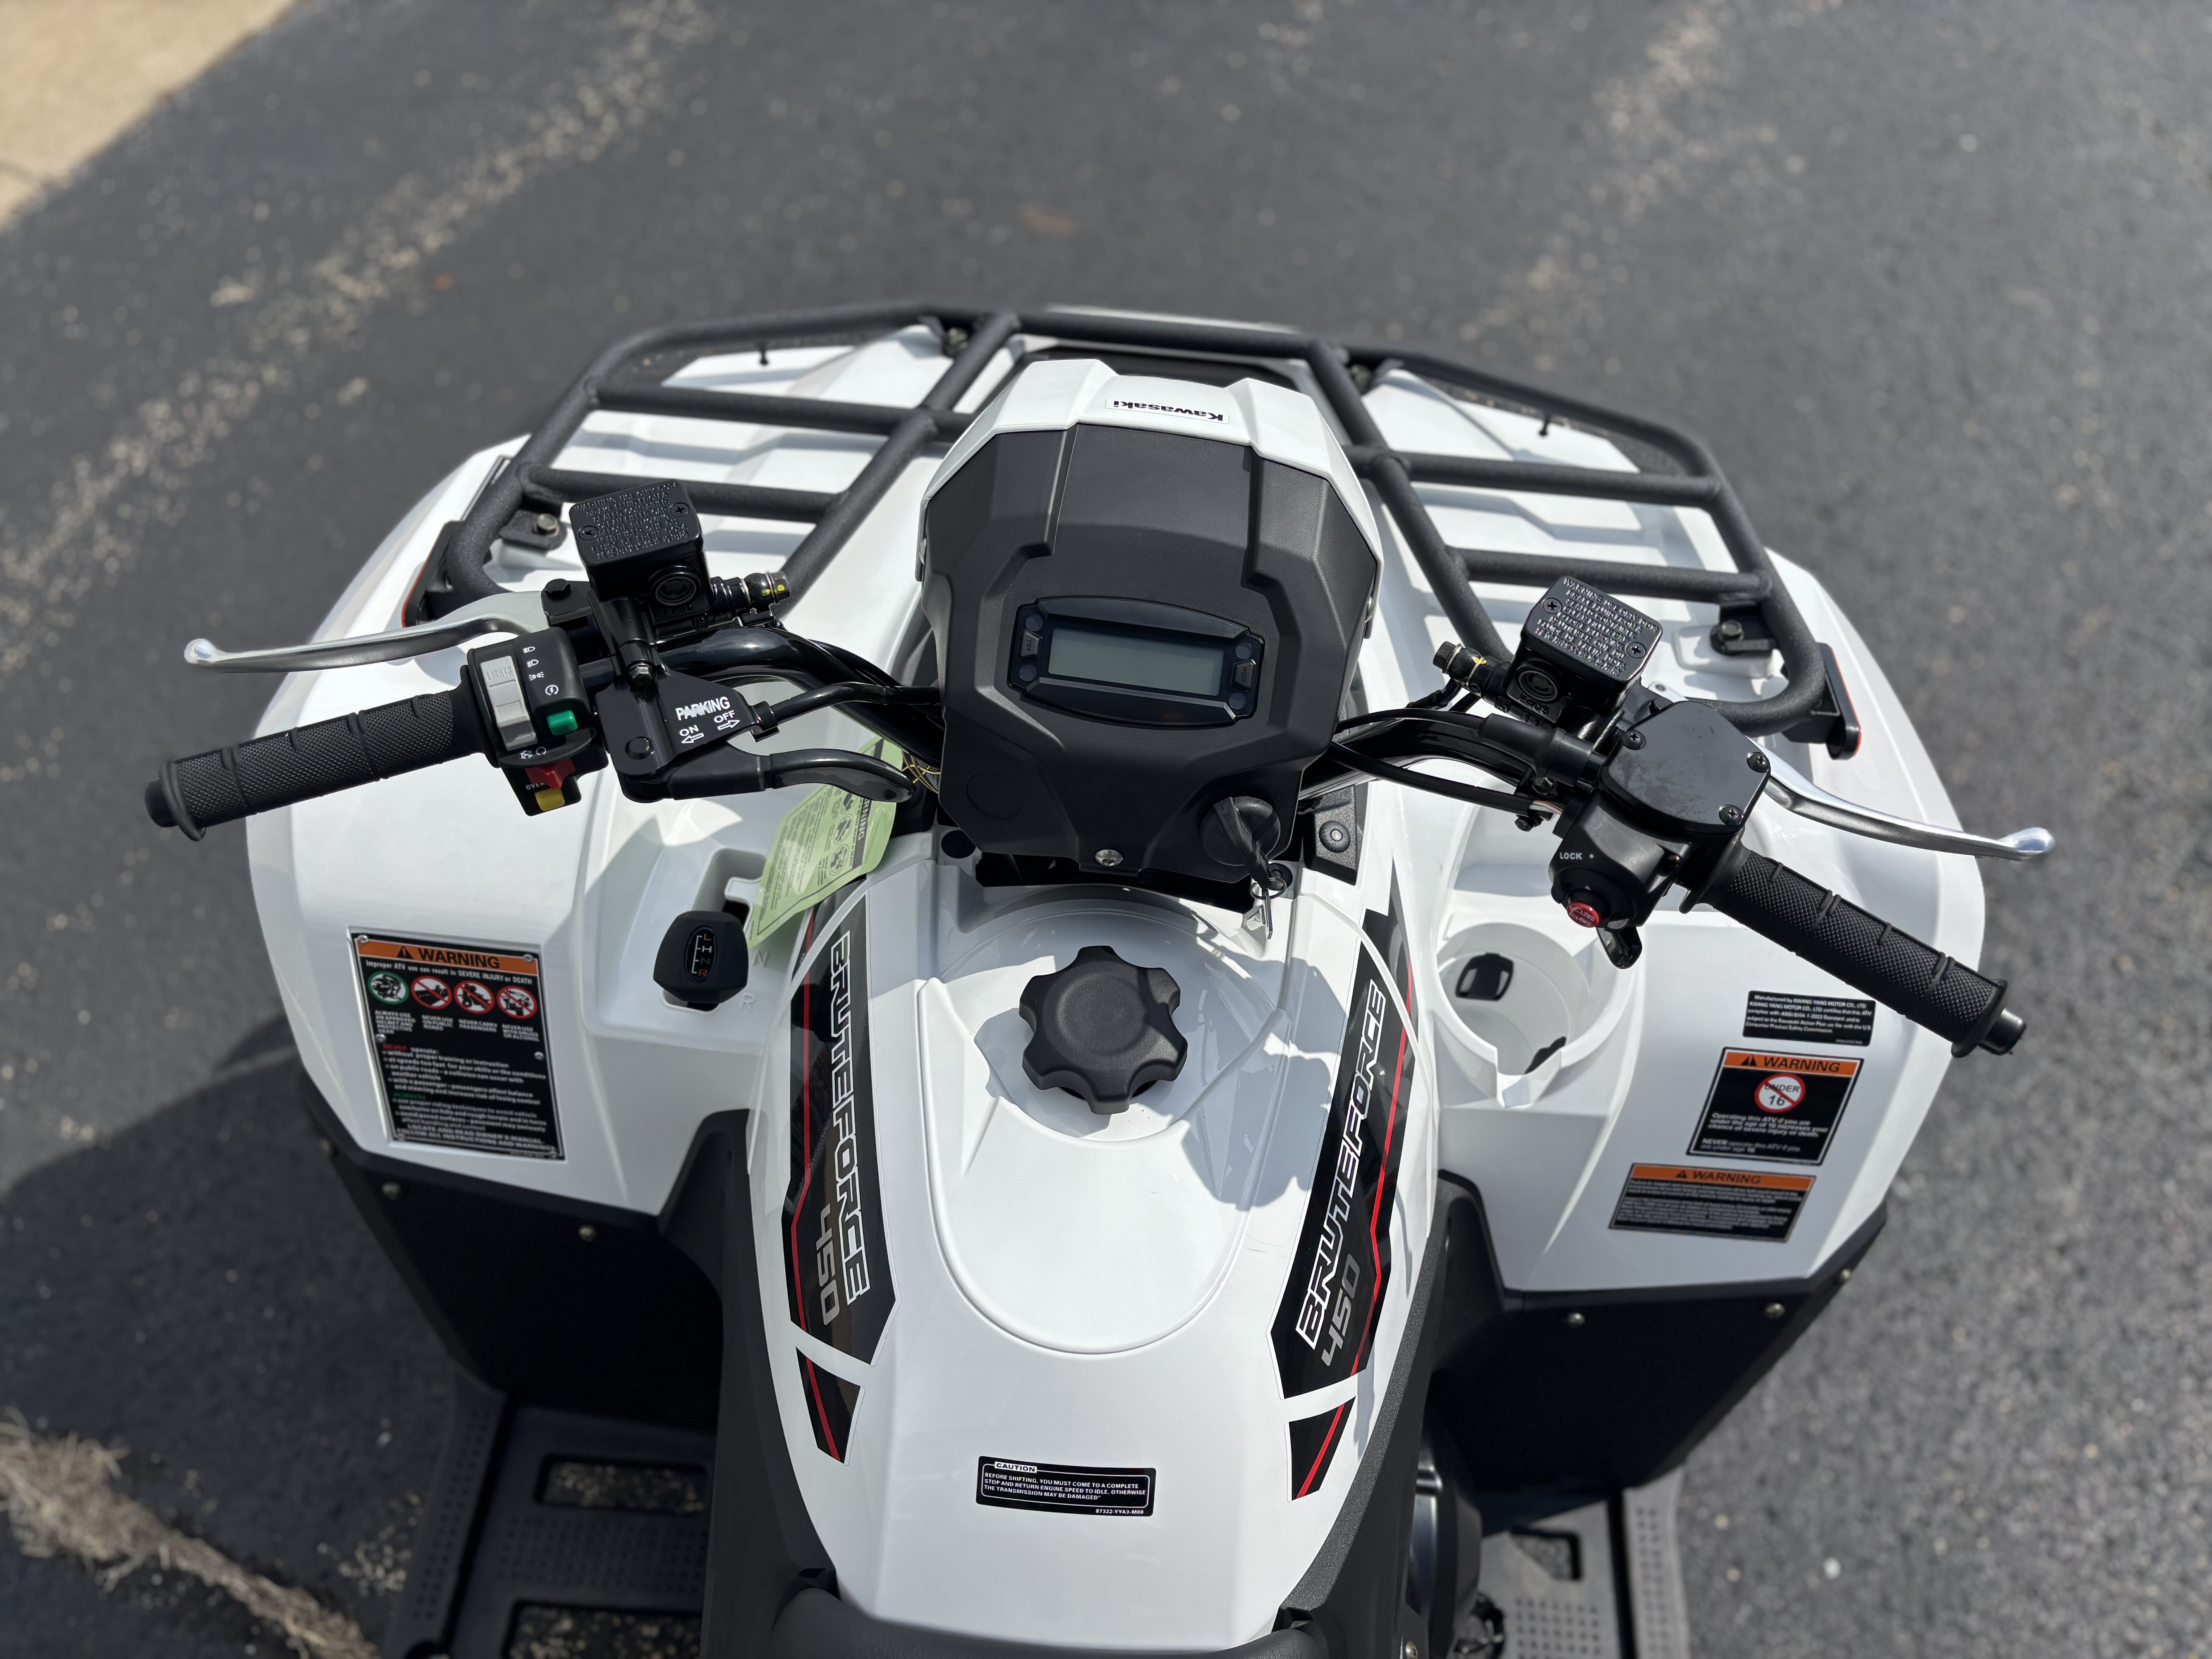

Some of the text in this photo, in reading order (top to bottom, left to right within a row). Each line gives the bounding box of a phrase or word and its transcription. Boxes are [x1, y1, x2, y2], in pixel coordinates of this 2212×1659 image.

[1113, 401, 1223, 422] Kawasaki
[486, 666, 513, 680] LIGHTS
[675, 696, 730, 721] PARKING
[713, 710, 735, 723] OFF
[679, 725, 699, 737] ON
[1559, 852, 1583, 860] LOCK
[1579, 917, 1591, 926] 4WD
[1583, 912, 1595, 921] 2WD
[418, 948, 500, 969] WARNING
[752, 950, 768, 967] N
[366, 960, 392, 969] Improper
[458, 970, 480, 978] SEVERE
[512, 976, 532, 984] DEATH
[740, 992, 755, 1011] R
[1764, 1056, 1841, 1072] WARNING
[1764, 1084, 1800, 1092] UNDER
[1769, 1095, 1785, 1106] 16
[1712, 1113, 1746, 1122] Operating
[1693, 1170, 1761, 1184] WARNING
[815, 1203, 840, 1326] 450
[1321, 1251, 1361, 1367] 450
[996, 1463, 1036, 1472] CAUTION
[996, 1486, 1042, 1496] TRANSMISSION
